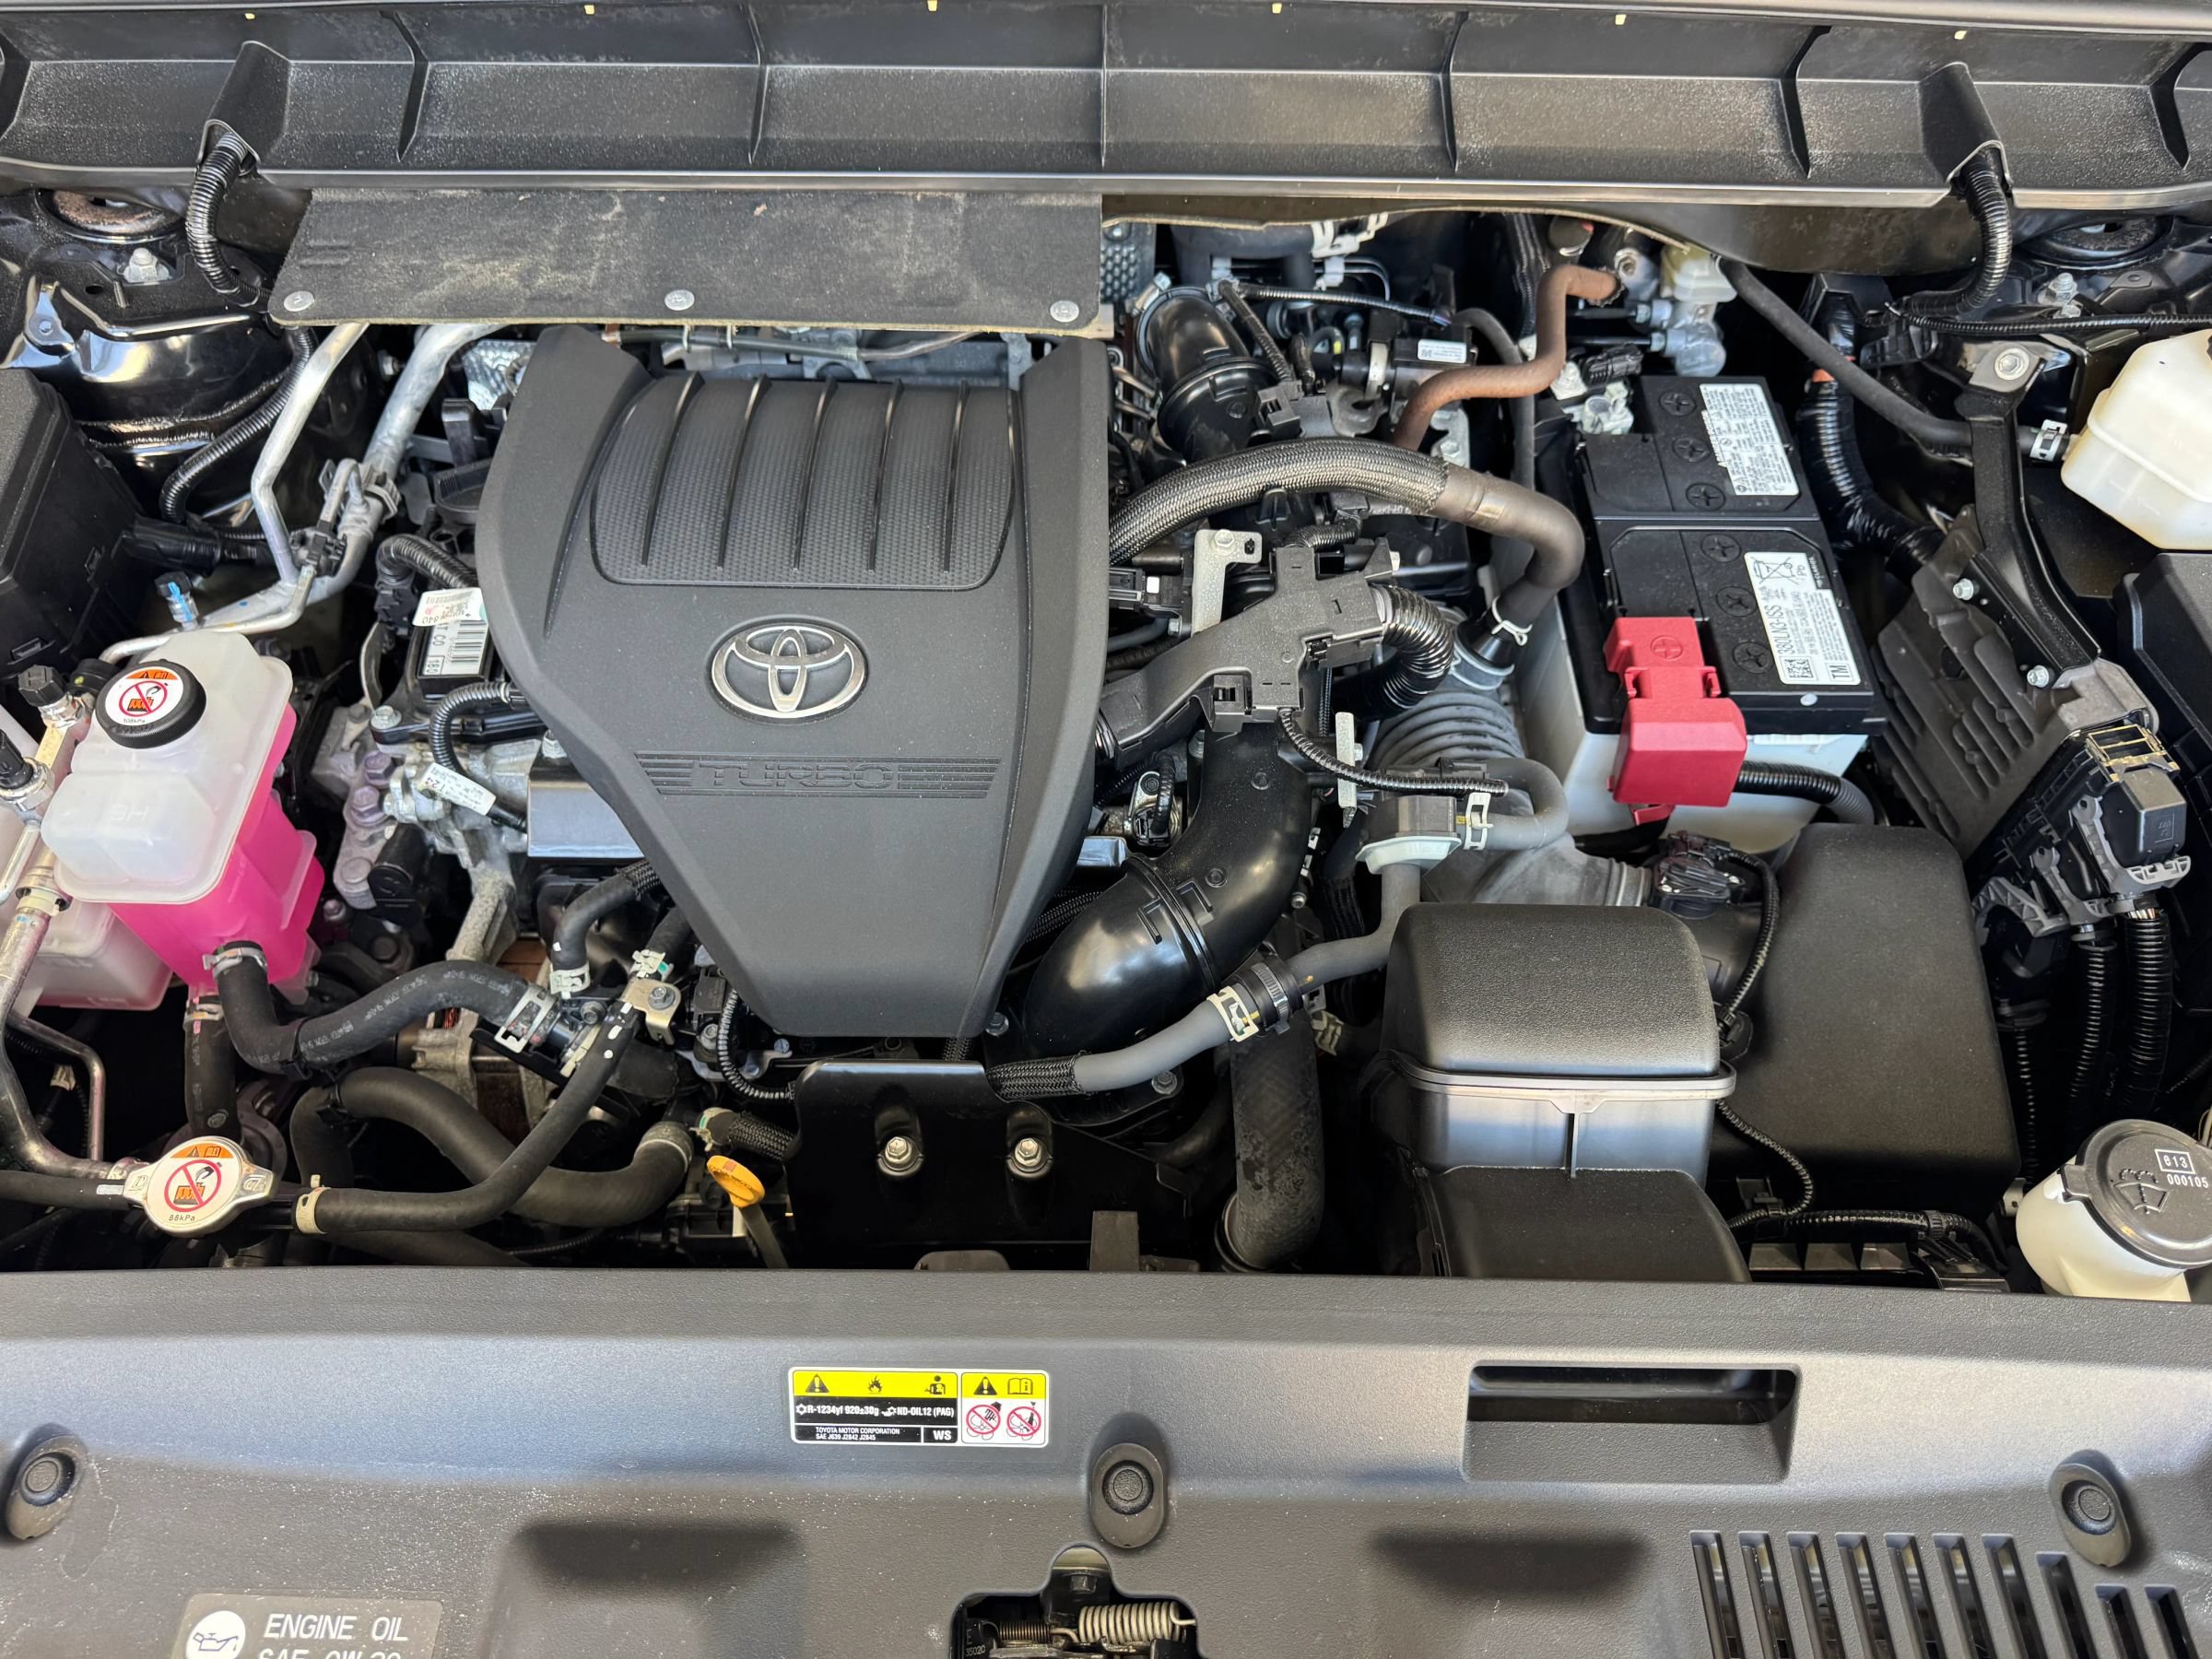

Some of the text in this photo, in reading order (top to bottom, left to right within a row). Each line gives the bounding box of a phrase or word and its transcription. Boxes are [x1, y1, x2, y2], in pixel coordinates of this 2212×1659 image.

[1829, 665, 1851, 679] TM
[699, 760, 894, 789] TURBO
[2163, 1155, 2188, 1168] e13
[2166, 1173, 2209, 1188] 000105
[169, 1214, 195, 1222] 88kPa
[807, 1405, 843, 1416] R-1234yf
[897, 1406, 932, 1417] ND-OIL12
[933, 1406, 955, 1418] (PAG)
[933, 1430, 952, 1441] WS
[264, 1613, 409, 1641] ENGINE OIL
